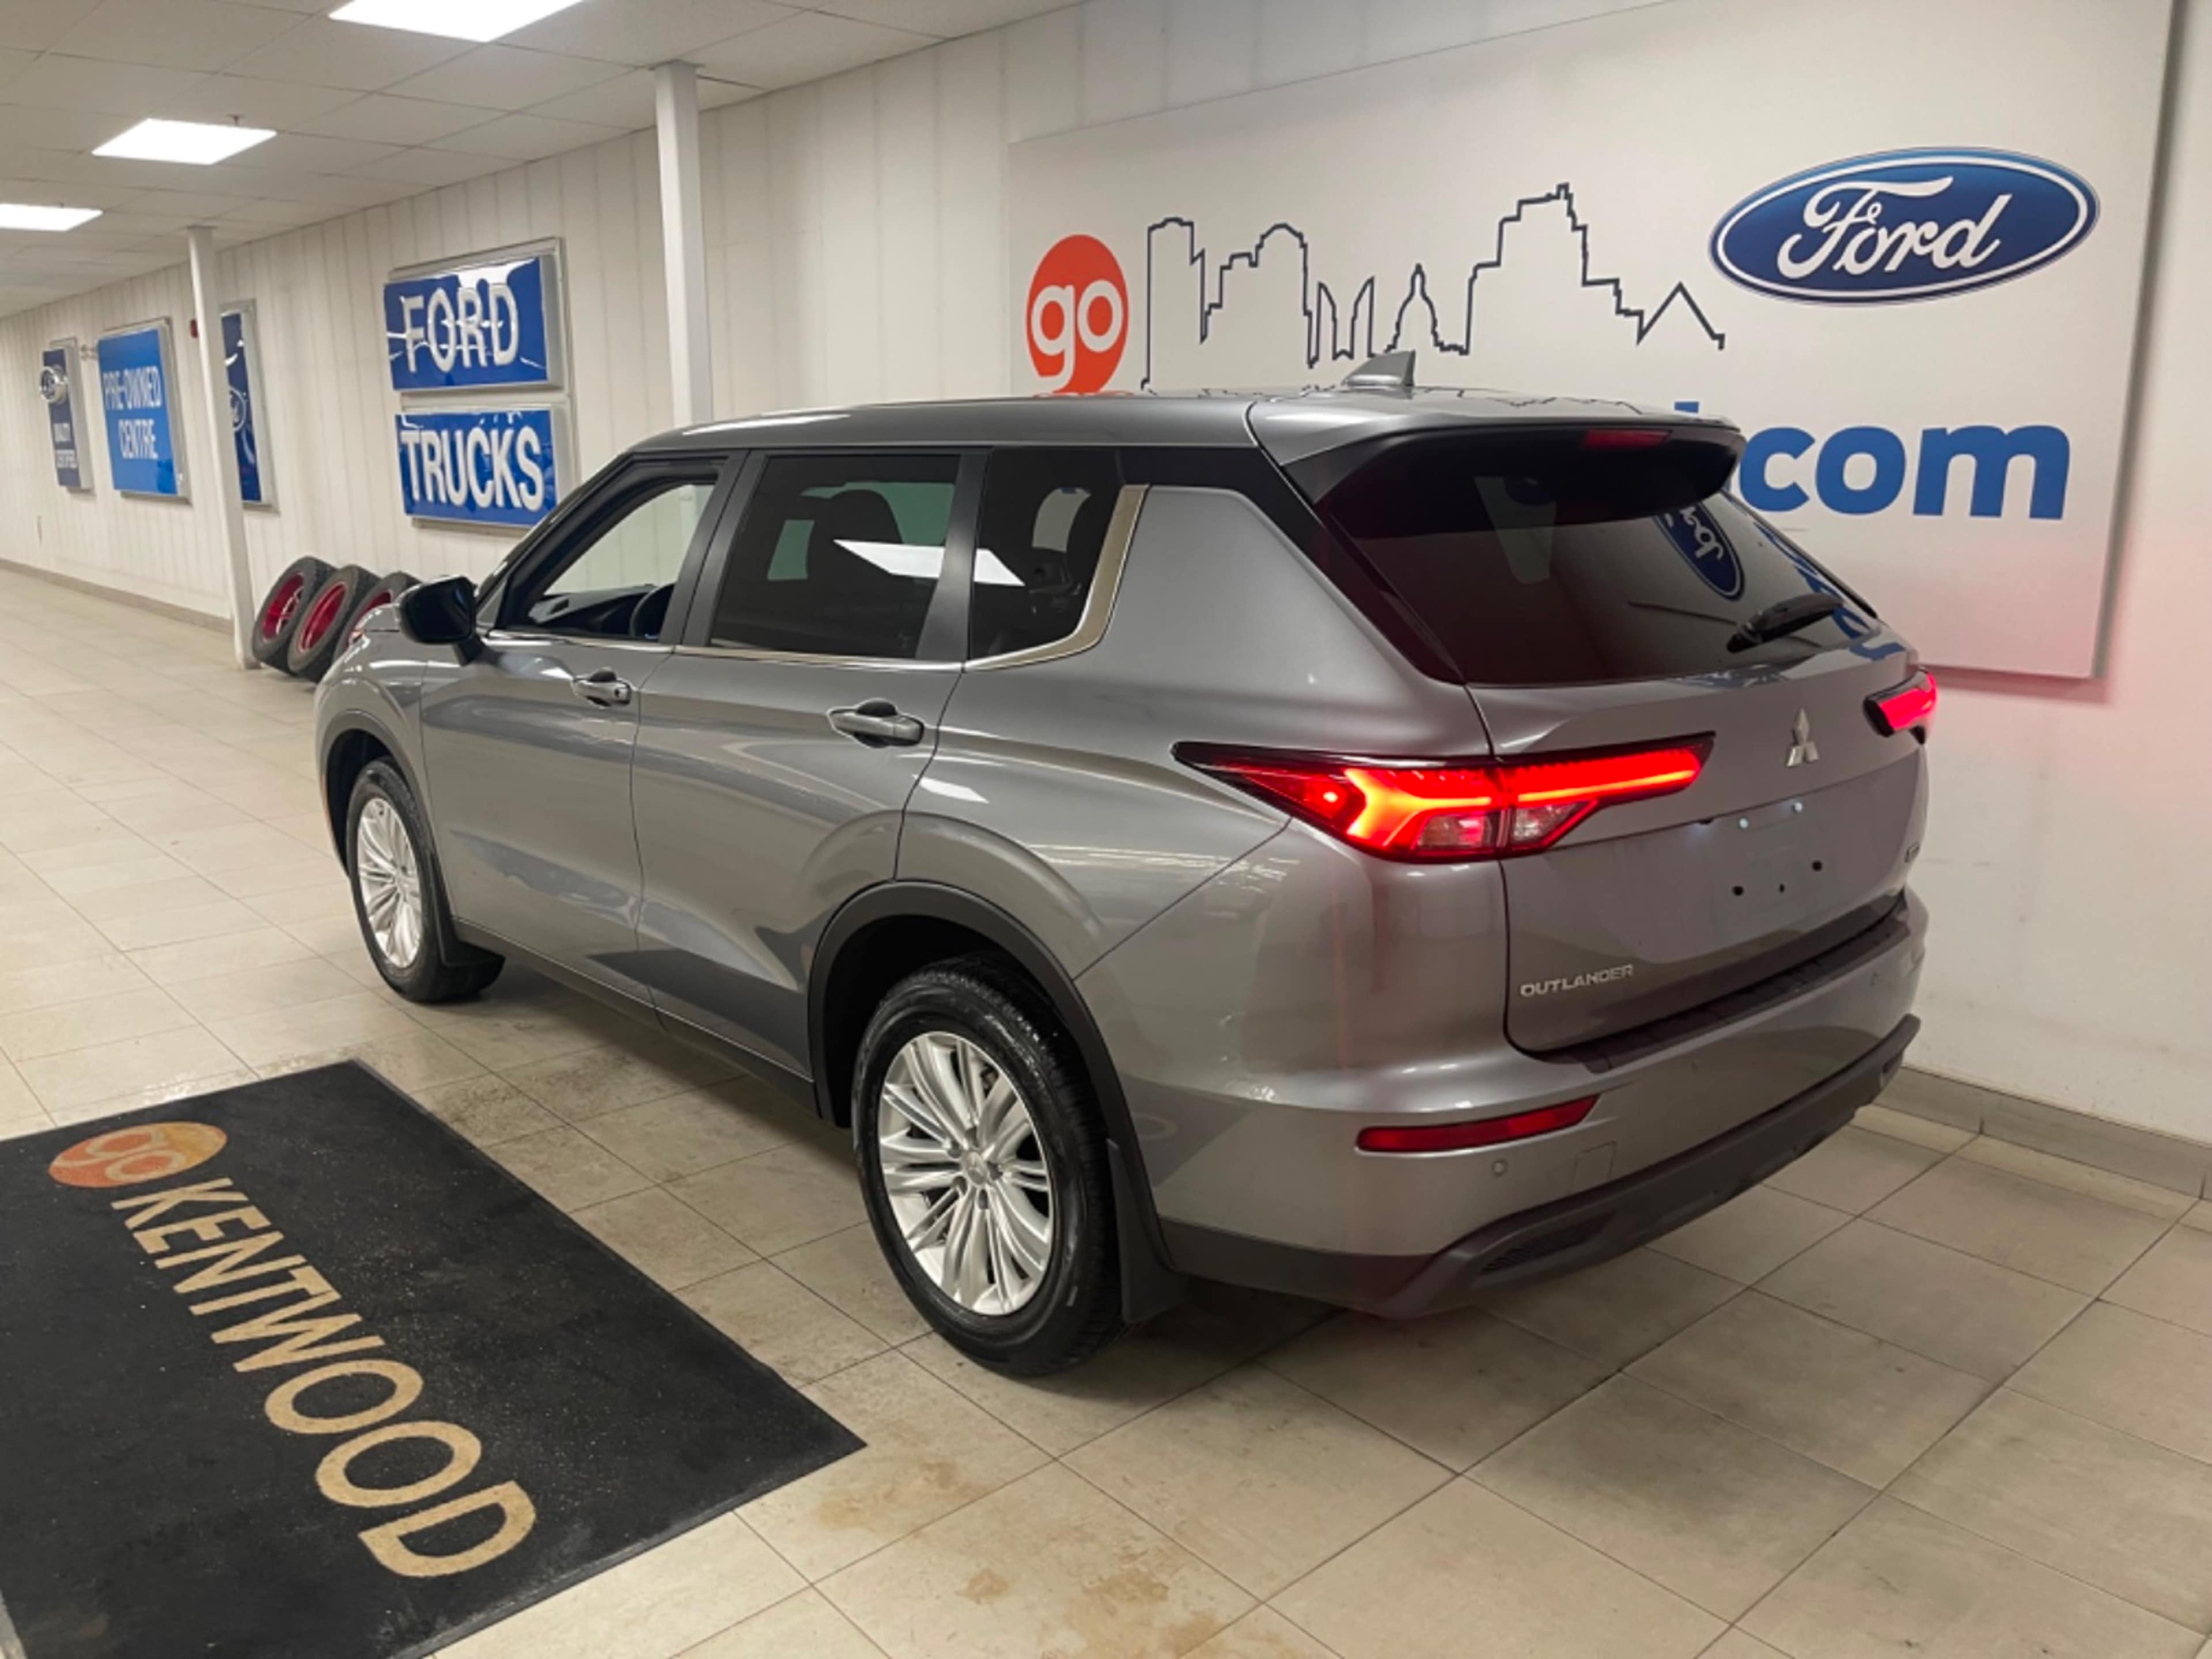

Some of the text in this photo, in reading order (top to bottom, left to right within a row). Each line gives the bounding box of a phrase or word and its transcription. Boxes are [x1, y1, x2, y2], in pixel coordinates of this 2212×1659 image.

[1777, 176, 2012, 279] Ford
[400, 283, 518, 373] FORD
[1031, 278, 1123, 394] go
[103, 365, 161, 410] PRE-OWNED
[118, 419, 158, 459] CENTRE
[401, 425, 543, 511] TRUCKS
[1721, 425, 2070, 520] com
[1520, 964, 1634, 997] OUTLANDER
[53, 1127, 185, 1181] go
[111, 1177, 537, 1578] KENTWOOD
